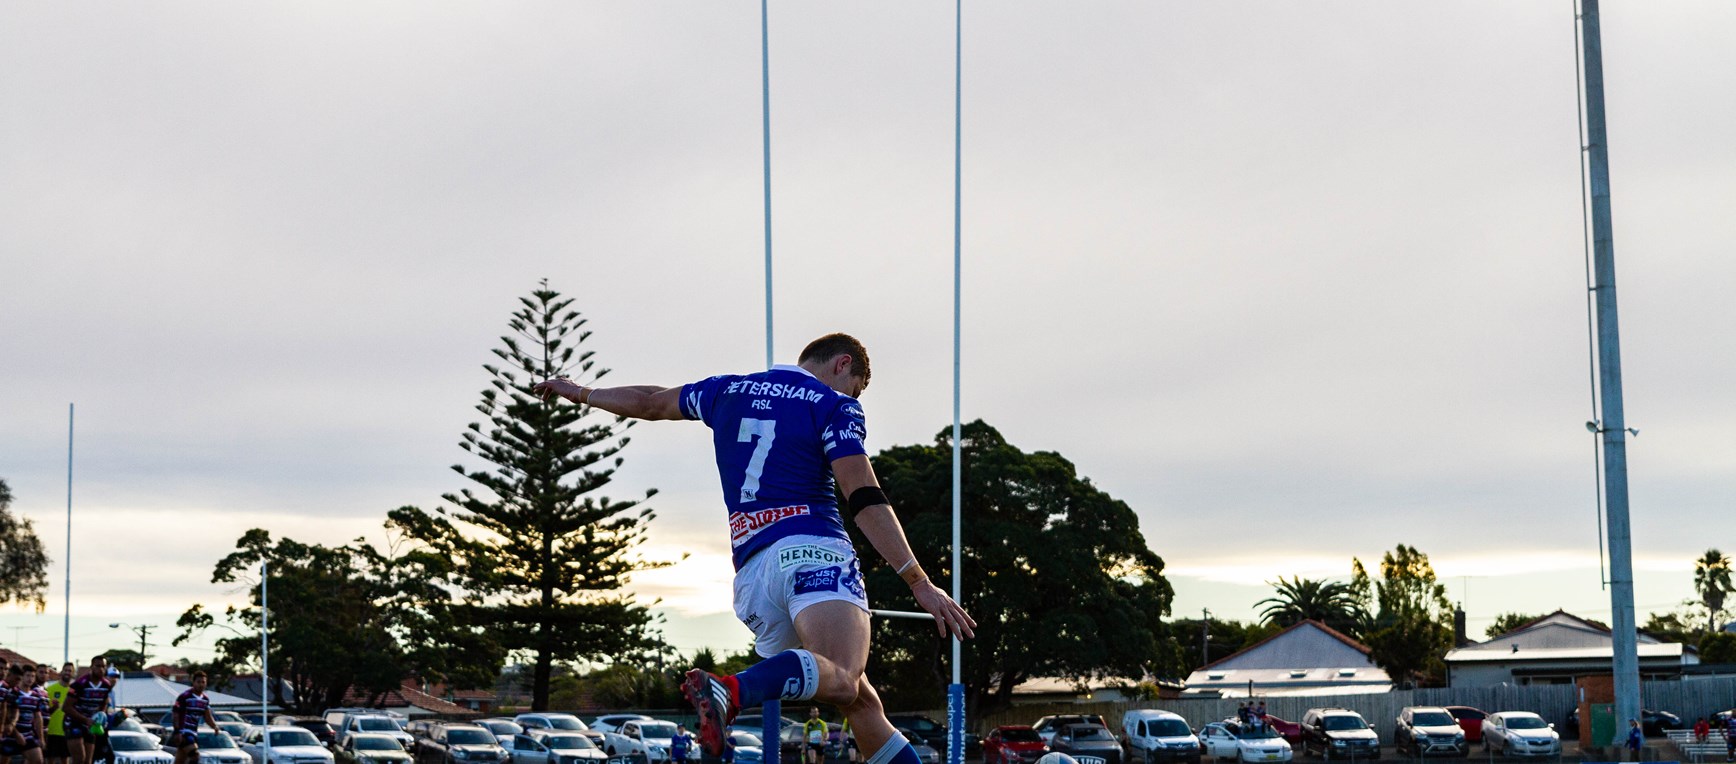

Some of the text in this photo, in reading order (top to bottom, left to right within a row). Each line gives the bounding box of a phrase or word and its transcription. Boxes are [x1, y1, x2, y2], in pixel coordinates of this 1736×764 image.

[751, 399, 772, 409] RSL
[737, 417, 776, 503] 7
[781, 549, 845, 564] HENSON
